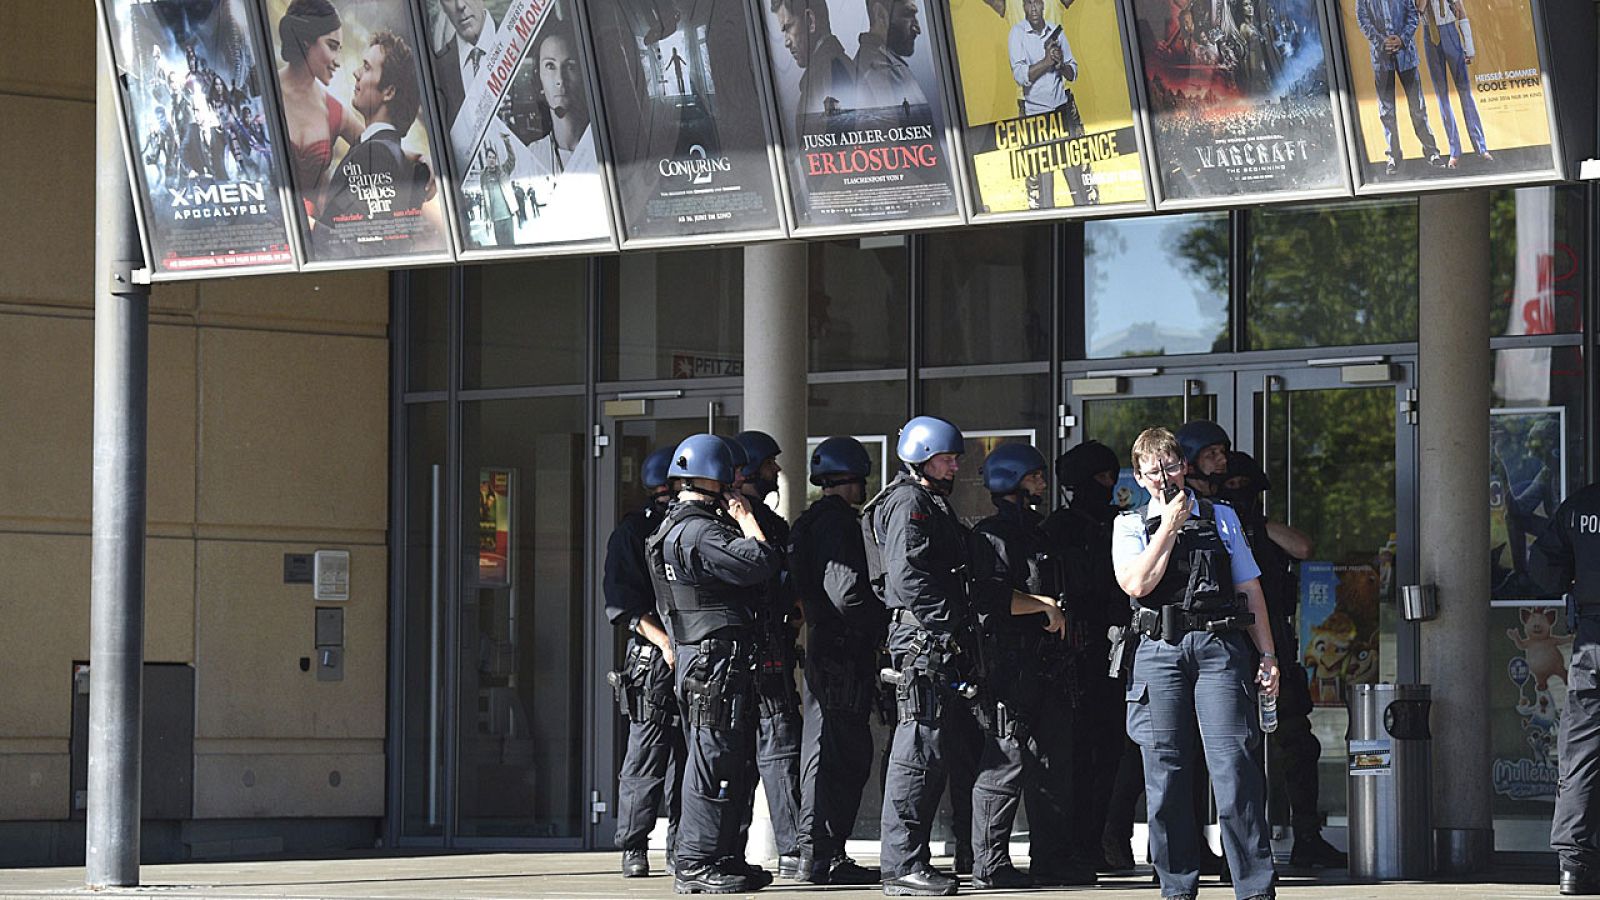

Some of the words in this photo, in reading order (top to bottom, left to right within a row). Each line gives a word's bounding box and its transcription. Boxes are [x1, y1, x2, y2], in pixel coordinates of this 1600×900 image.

[487, 38, 520, 97] MONEY
[1504, 69, 1538, 78] SOMMER
[1477, 80, 1507, 92] COOLE
[1508, 77, 1540, 89] TYPEN
[803, 133, 837, 151] JUSSI
[839, 125, 933, 146] ADLER-OLSEN
[994, 111, 1070, 151] CENTRAL
[806, 144, 938, 176] ERLÖSUNG
[1009, 131, 1120, 180] INTELLIGENCE
[1195, 138, 1308, 168] WARCRAFT
[343, 161, 362, 176] ein
[659, 157, 731, 182] CONJURING
[168, 181, 266, 207] X-MEN
[174, 204, 268, 220] APOCALYPSE
[1580, 514, 1600, 534] PO
